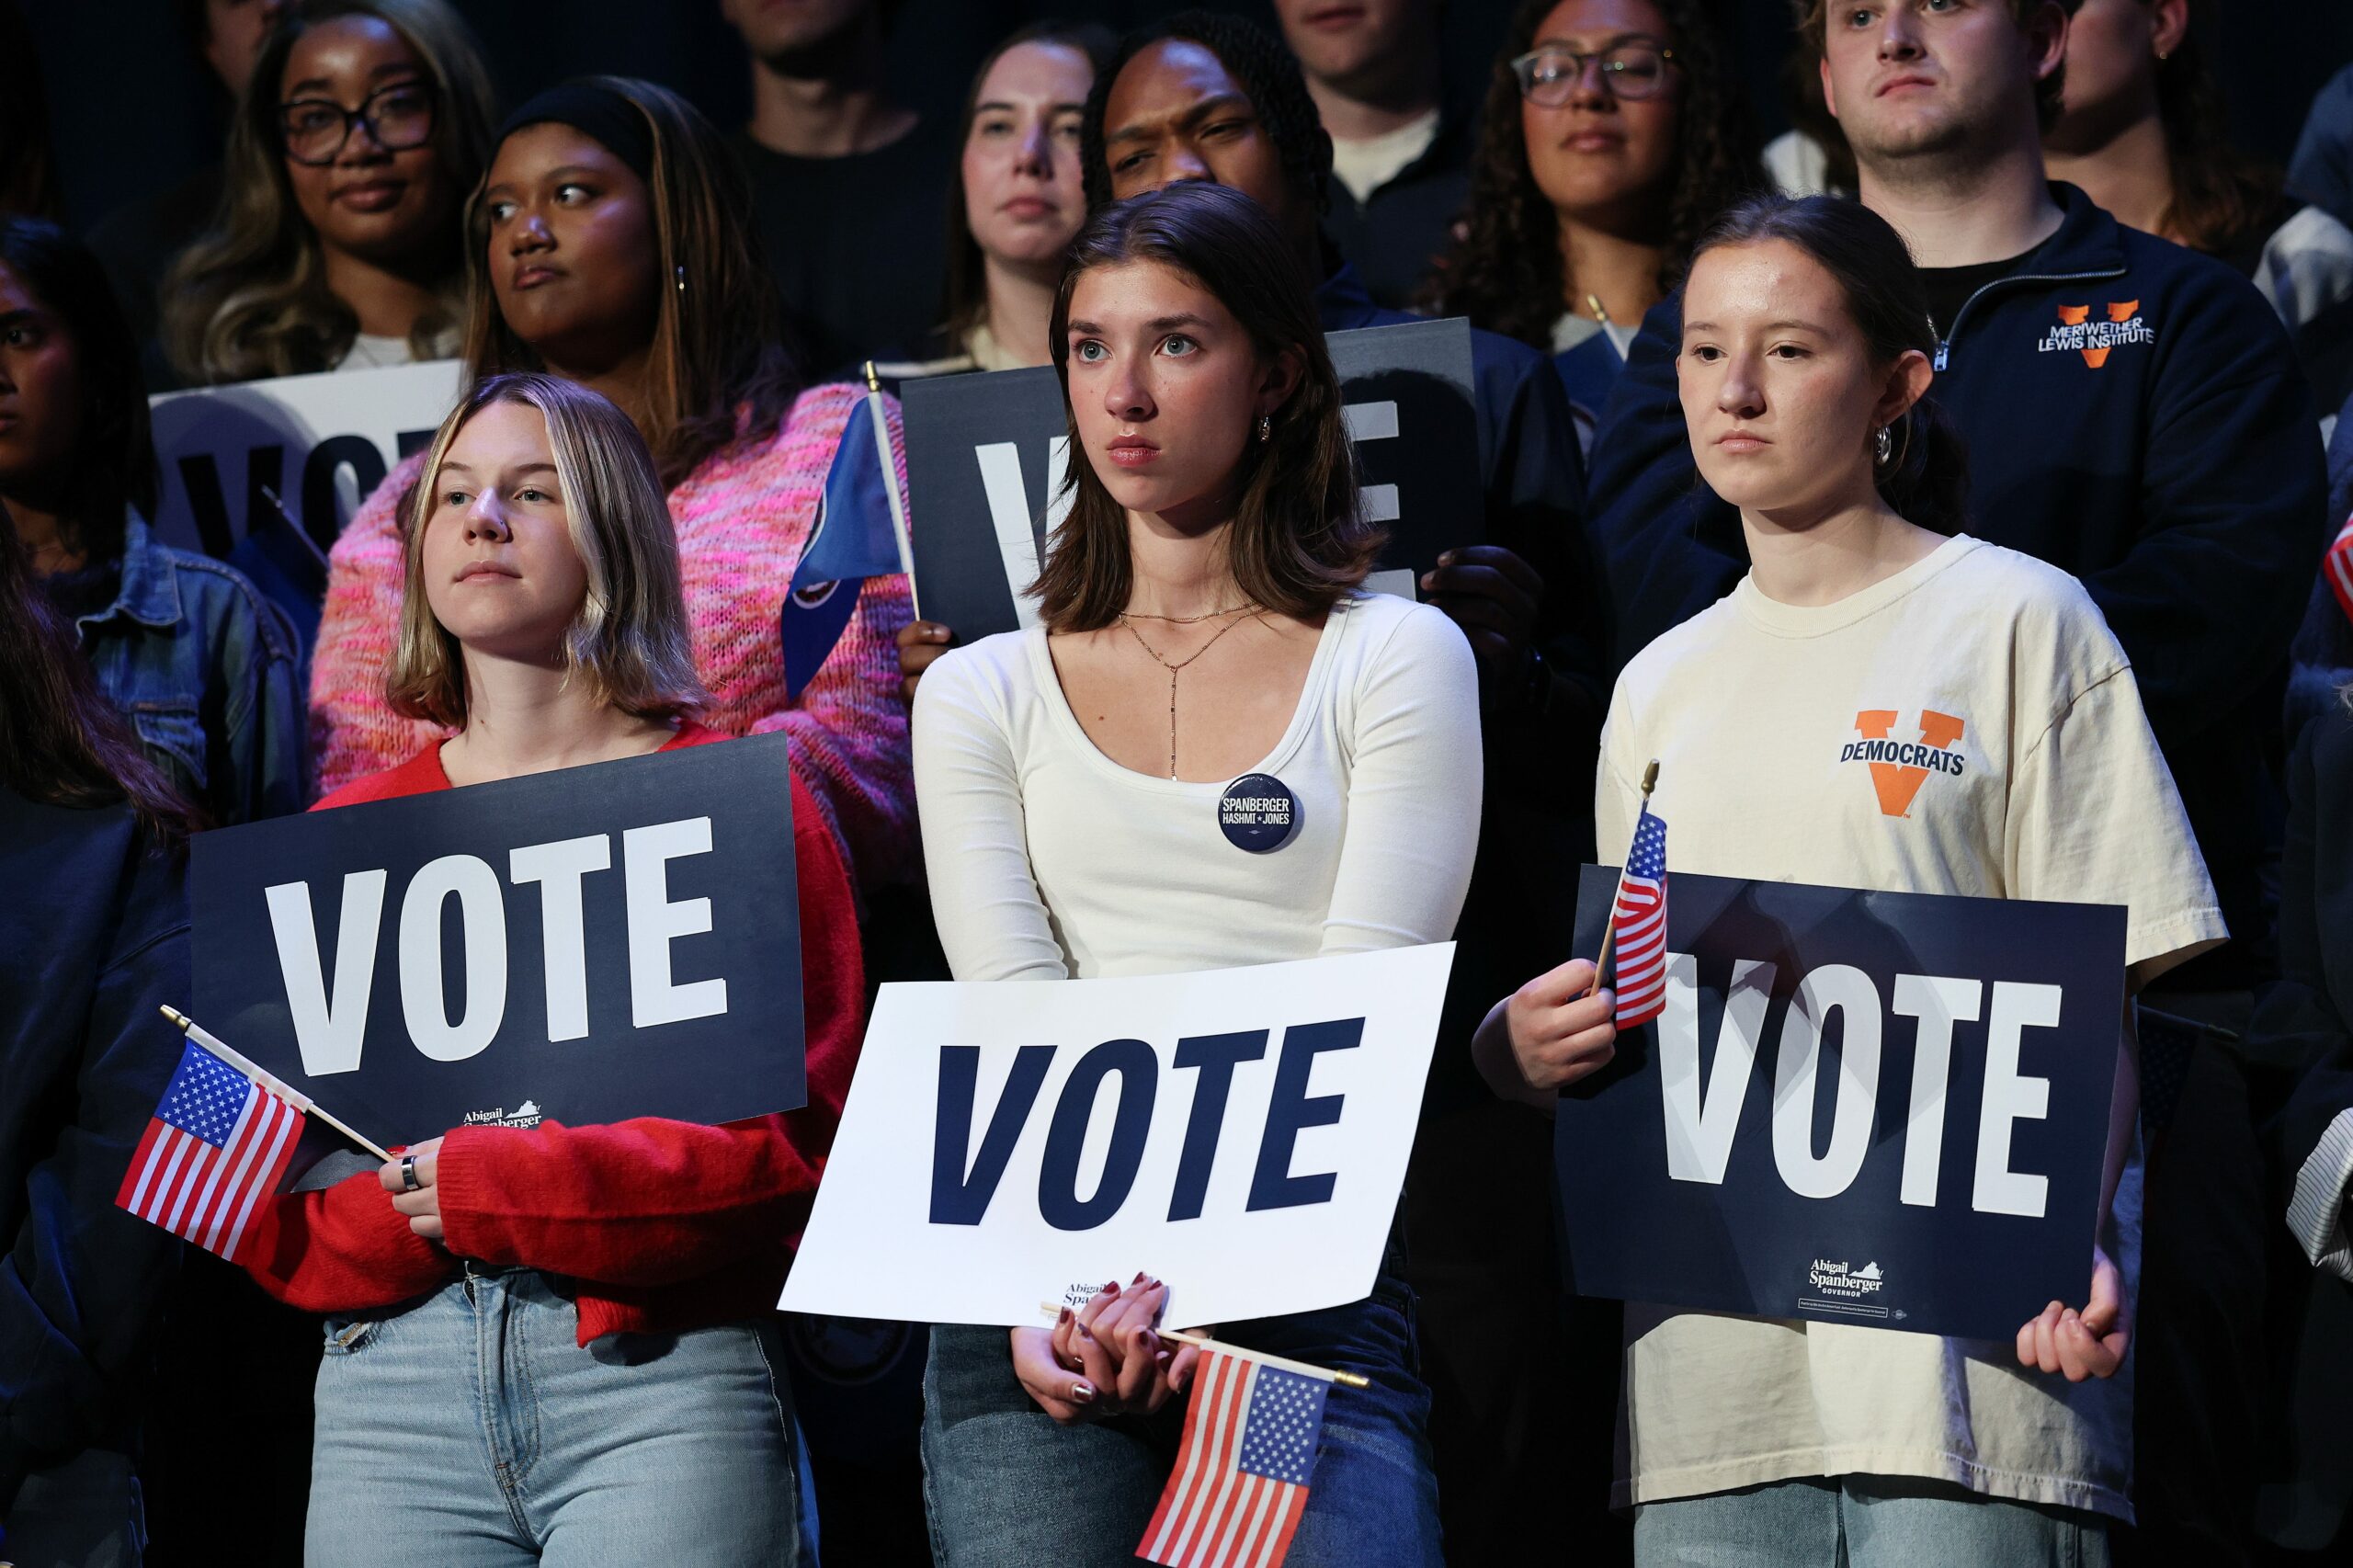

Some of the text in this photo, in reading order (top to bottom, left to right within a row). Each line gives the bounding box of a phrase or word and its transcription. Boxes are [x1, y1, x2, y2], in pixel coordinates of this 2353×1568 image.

[2050, 316, 2143, 339] MERIWETHER
[2038, 328, 2154, 352] LEWIS INSTITUTE
[974, 400, 1417, 630] VE
[1840, 740, 1964, 776] DEMOCRATS
[1222, 798, 1290, 812] SPANBERGER
[1222, 812, 1290, 824] HASHMI JONES
[265, 816, 727, 1076] VOTE
[1657, 952, 2063, 1219] VOTE
[463, 1108, 503, 1123] Abigail
[929, 1017, 1365, 1231] VOTE
[1811, 1258, 1848, 1275] Abigail
[1809, 1271, 1882, 1293] Spanberger
[1822, 1288, 1861, 1299] GOVERNOR
